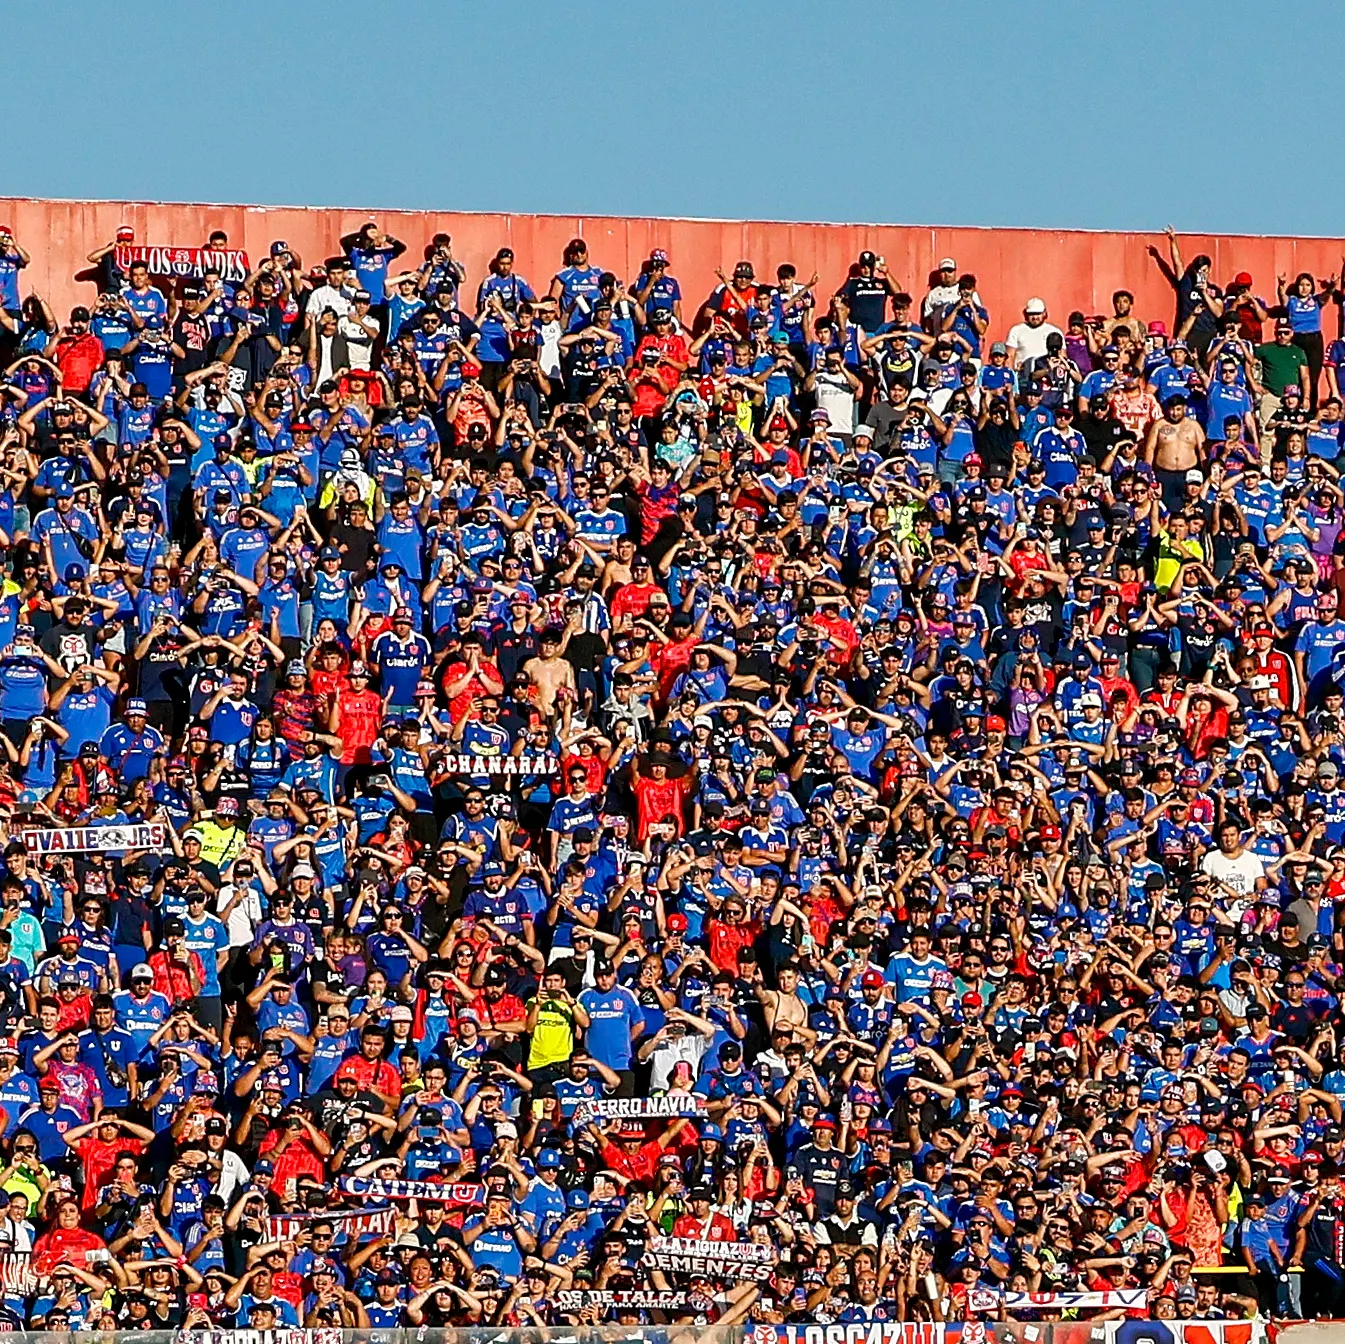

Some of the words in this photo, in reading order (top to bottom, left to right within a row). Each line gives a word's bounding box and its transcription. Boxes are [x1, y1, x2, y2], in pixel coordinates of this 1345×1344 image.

[193, 250, 247, 283] ANDES
[139, 354, 165, 363] Claro
[901, 439, 930, 449] Claro
[387, 657, 419, 668] Claro
[590, 1098, 641, 1116] CERRO
